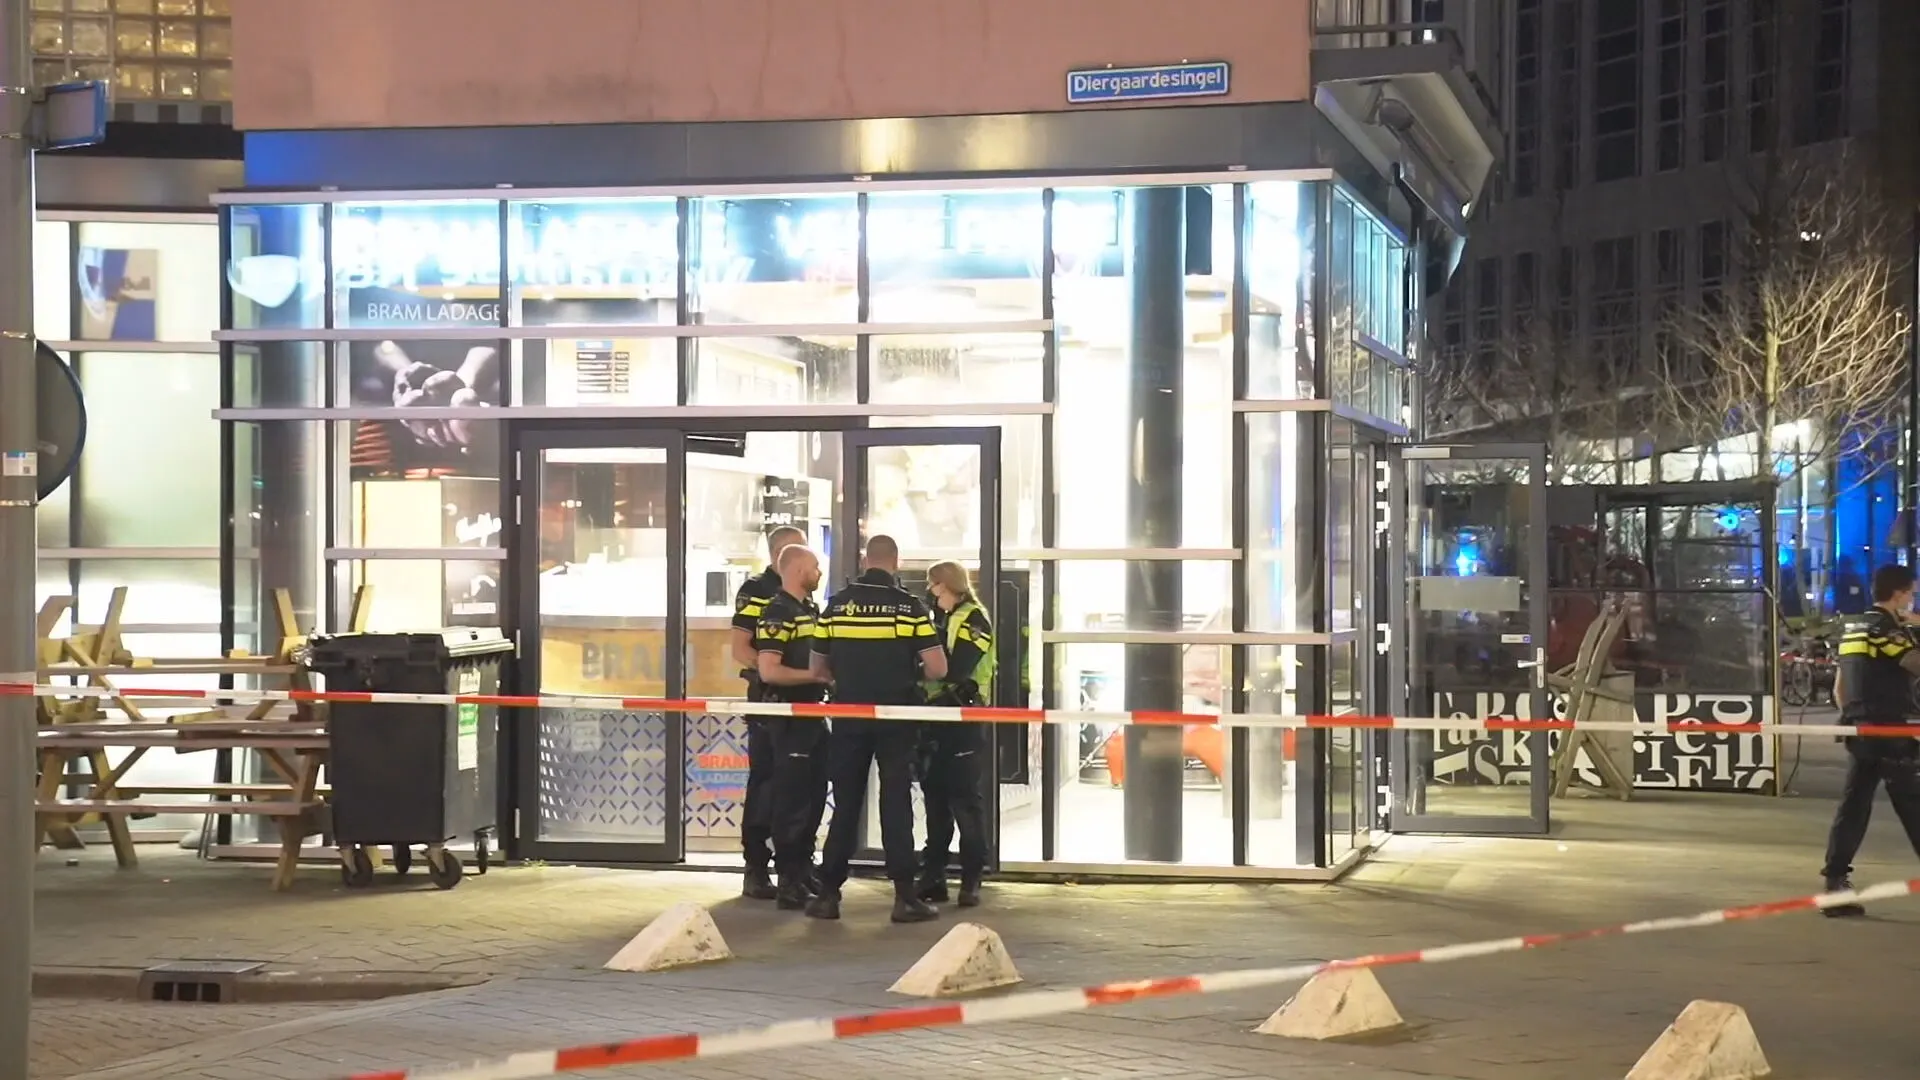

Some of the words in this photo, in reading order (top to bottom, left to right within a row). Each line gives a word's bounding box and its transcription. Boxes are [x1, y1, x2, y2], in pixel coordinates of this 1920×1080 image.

[1074, 68, 1222, 95] Diergaardesingel
[367, 303, 421, 321] BRAM
[426, 303, 500, 321] LADAGE
